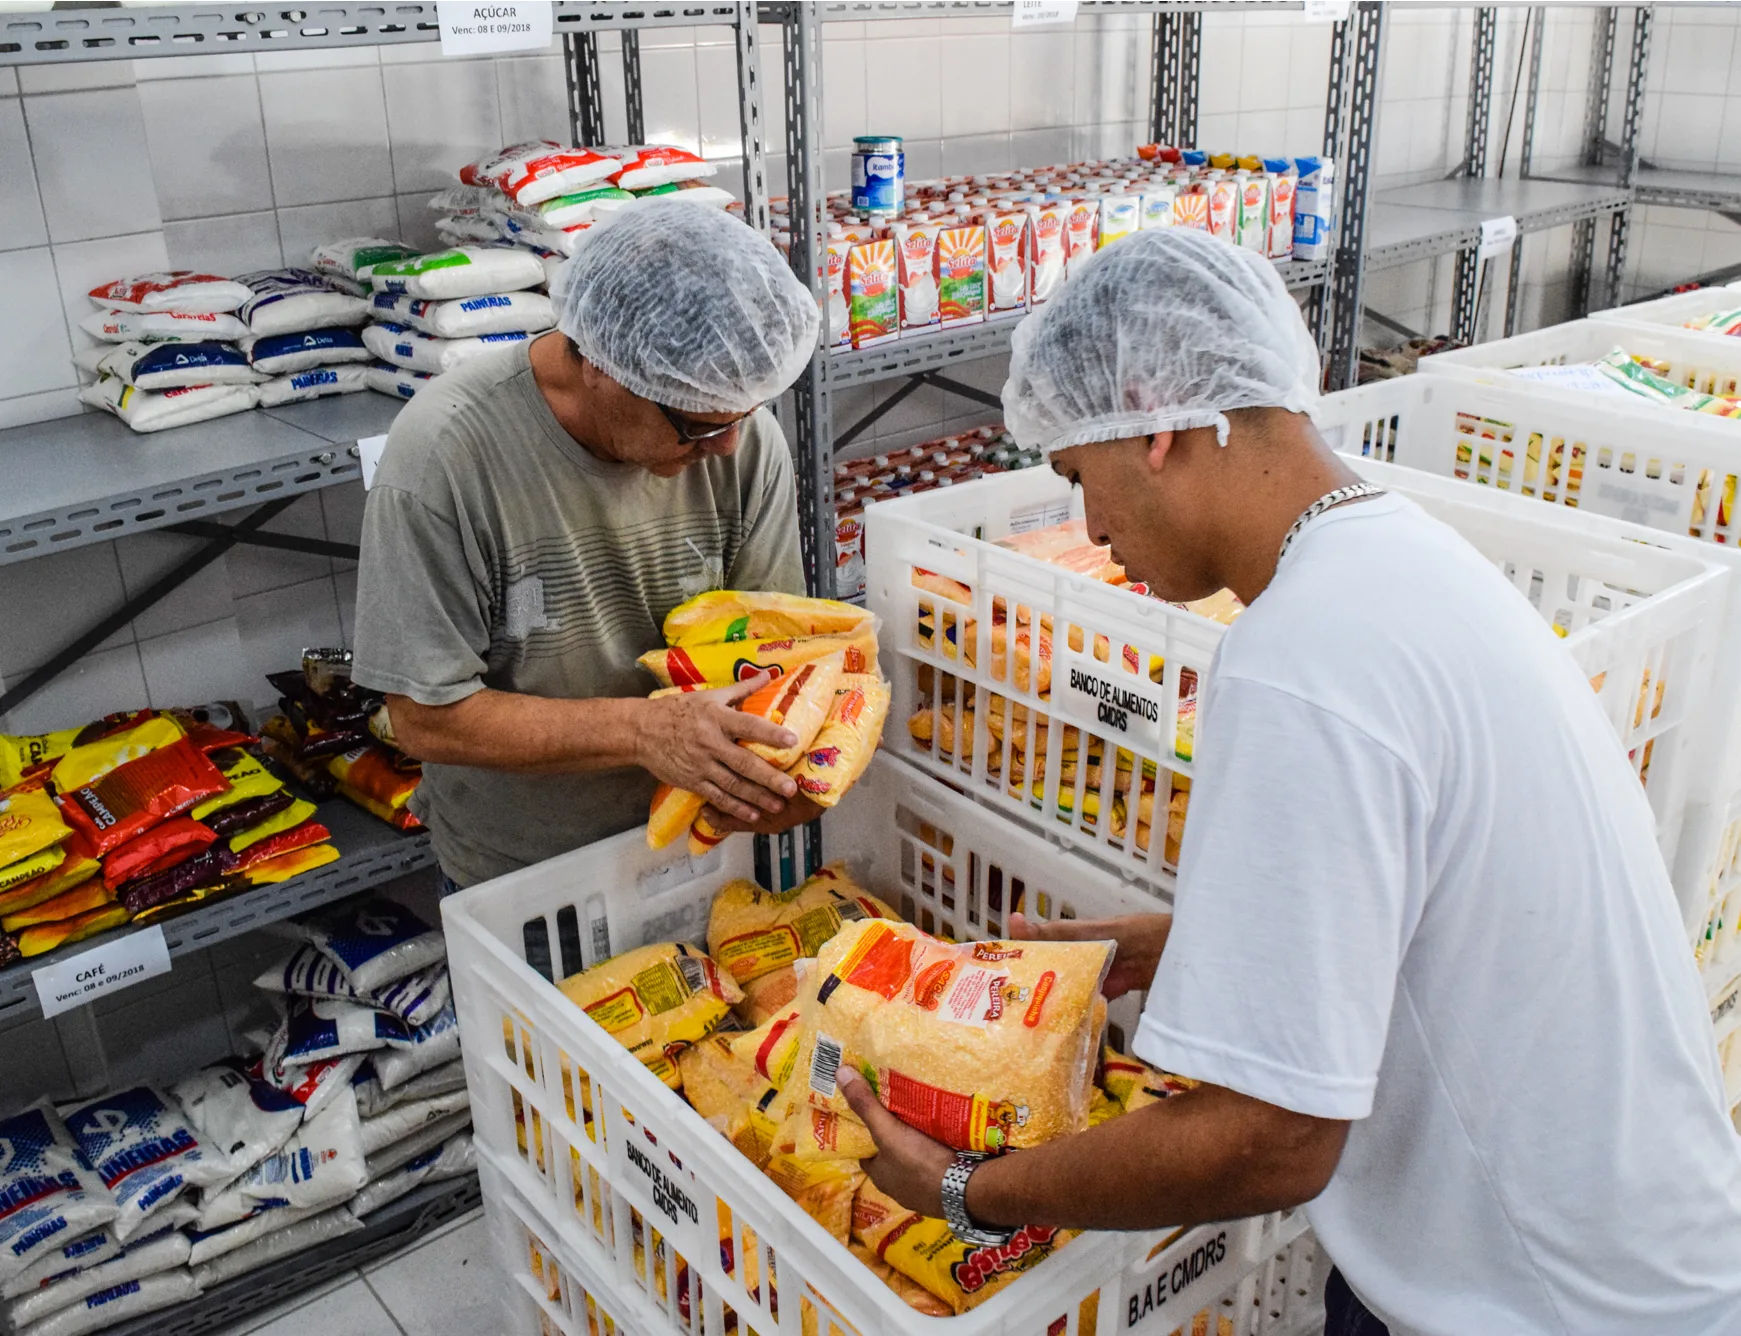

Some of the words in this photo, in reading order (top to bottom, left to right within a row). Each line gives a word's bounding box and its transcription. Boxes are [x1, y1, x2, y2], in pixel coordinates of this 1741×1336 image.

[473, 5, 517, 20] AÇÚCAR
[451, 26, 476, 35] Venc:
[477, 25, 488, 34] 08
[490, 25, 495, 33] E
[496, 23, 531, 34] 09/2018
[904, 237, 933, 249] Selita
[948, 255, 977, 268] Selita
[1070, 668, 1098, 697] BANCO
[1100, 680, 1111, 702] DE
[1112, 686, 1158, 722] ALIMENTOS
[1097, 701, 1127, 732] CMDRS
[55, 989, 82, 1002] Venc:
[84, 983, 96, 992] 08
[105, 964, 145, 984] 09/2018
[75, 963, 106, 983] CAFÉ
[934, 970, 950, 993] SAC
[989, 980, 1000, 1018] PEREIRA
[626, 1139, 651, 1178] BANCO
[651, 1162, 662, 1189] DE
[663, 1174, 699, 1225] ALIMENTO
[653, 1184, 678, 1225] CMDRS
[1128, 1284, 1154, 1328] B.A
[1156, 1272, 1168, 1307] E
[1171, 1231, 1227, 1294] CMDRS
